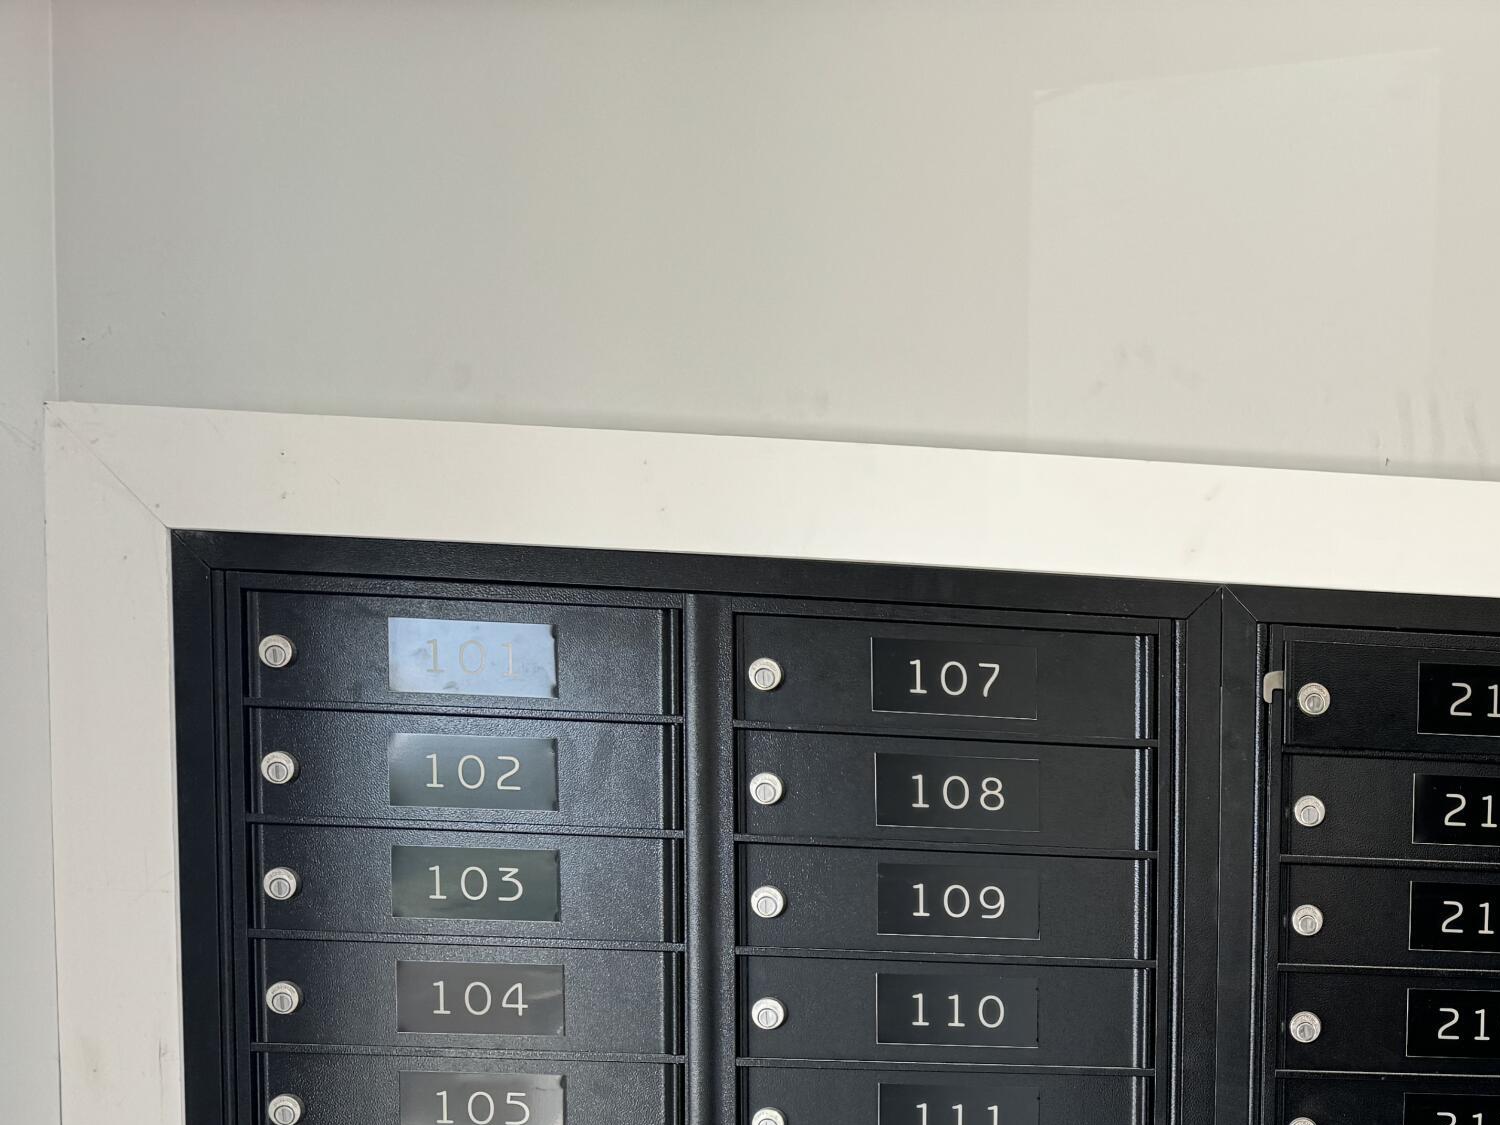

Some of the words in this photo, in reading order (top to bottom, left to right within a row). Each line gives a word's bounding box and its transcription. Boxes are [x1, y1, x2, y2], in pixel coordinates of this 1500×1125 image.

[426, 638, 518, 677] 101
[909, 659, 1000, 698] 107
[426, 753, 521, 791] 102
[911, 773, 1005, 811] 108
[428, 865, 524, 902] 103
[912, 883, 1005, 919] 109
[432, 980, 529, 1017] 104
[911, 992, 1005, 1029] 110
[436, 1090, 530, 1125] 105
